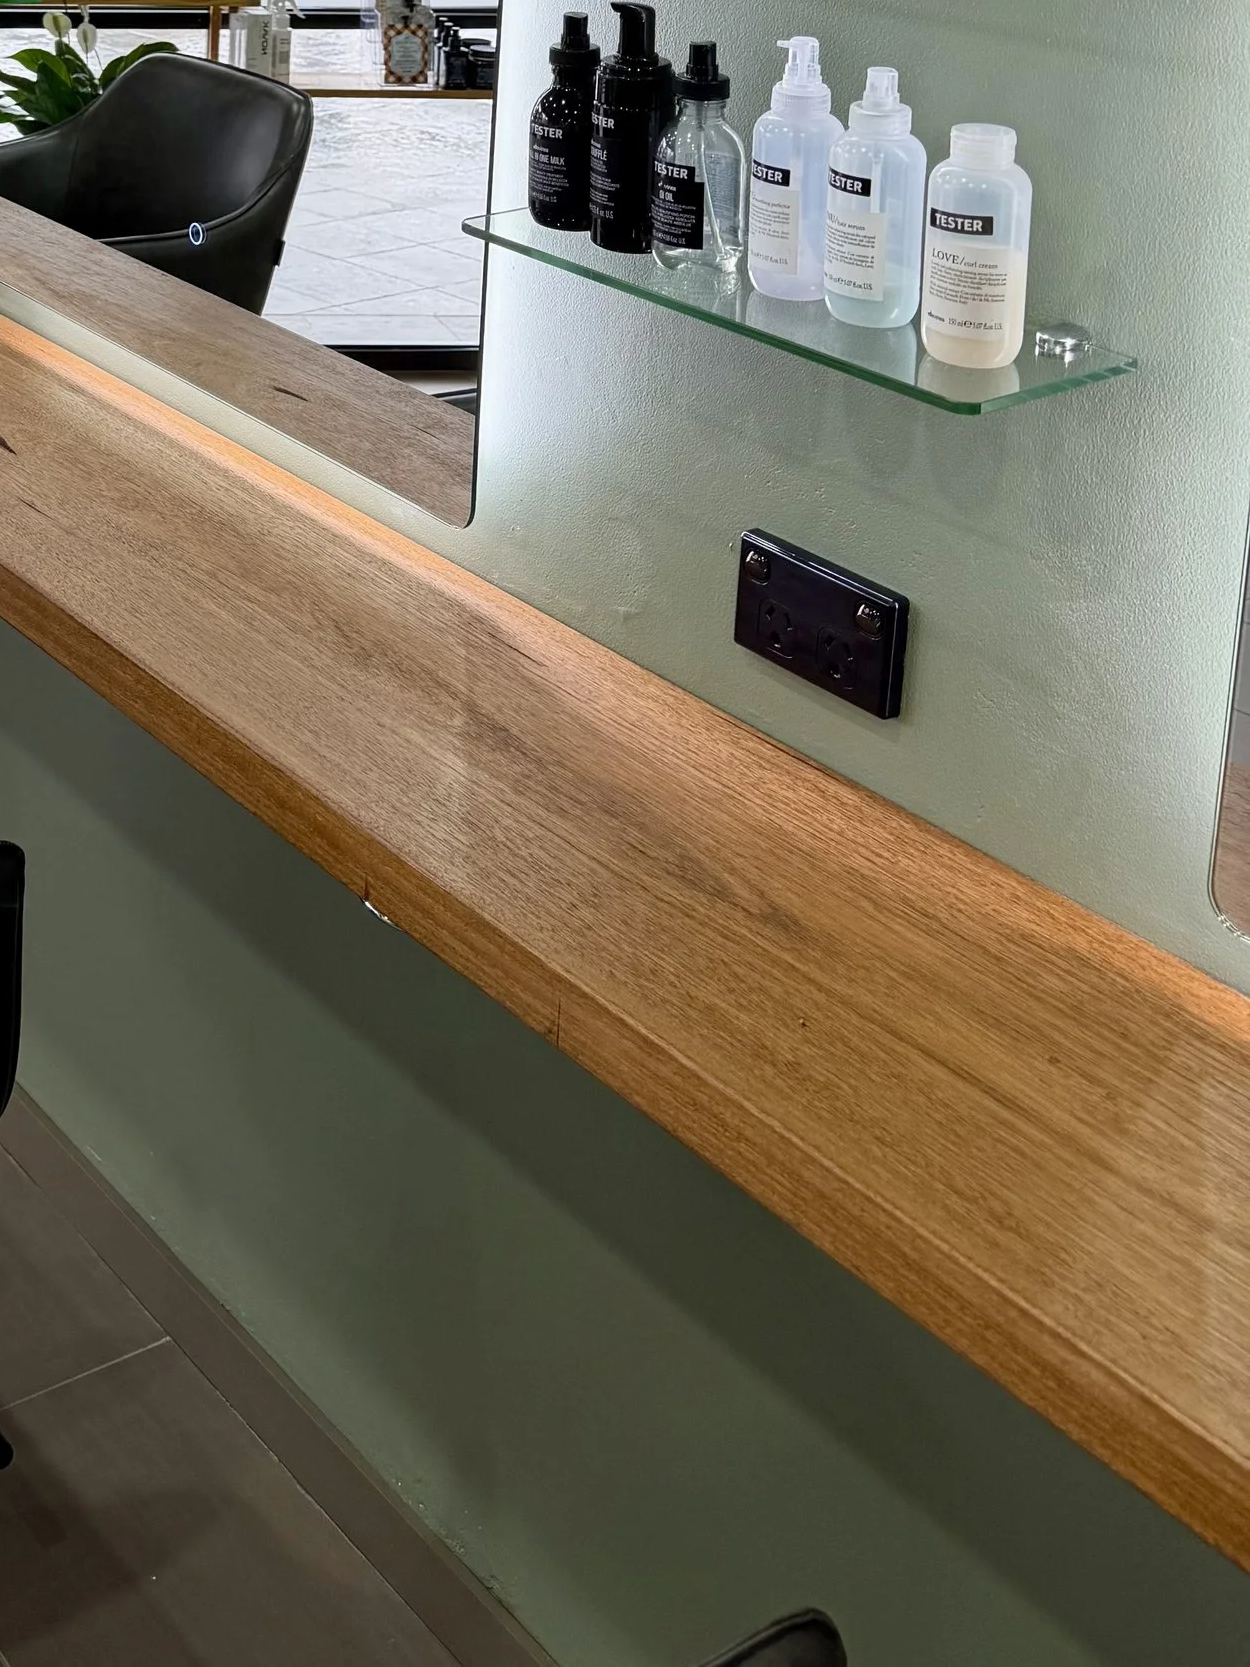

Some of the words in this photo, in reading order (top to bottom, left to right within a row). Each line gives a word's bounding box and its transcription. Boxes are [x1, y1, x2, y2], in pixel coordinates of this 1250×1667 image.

[592, 112, 615, 129] ESTER
[531, 123, 563, 139] TESTER
[654, 161, 688, 179] TESTER
[753, 165, 783, 183] ESTER
[831, 174, 862, 193] ESTER
[934, 213, 983, 232] TESTER
